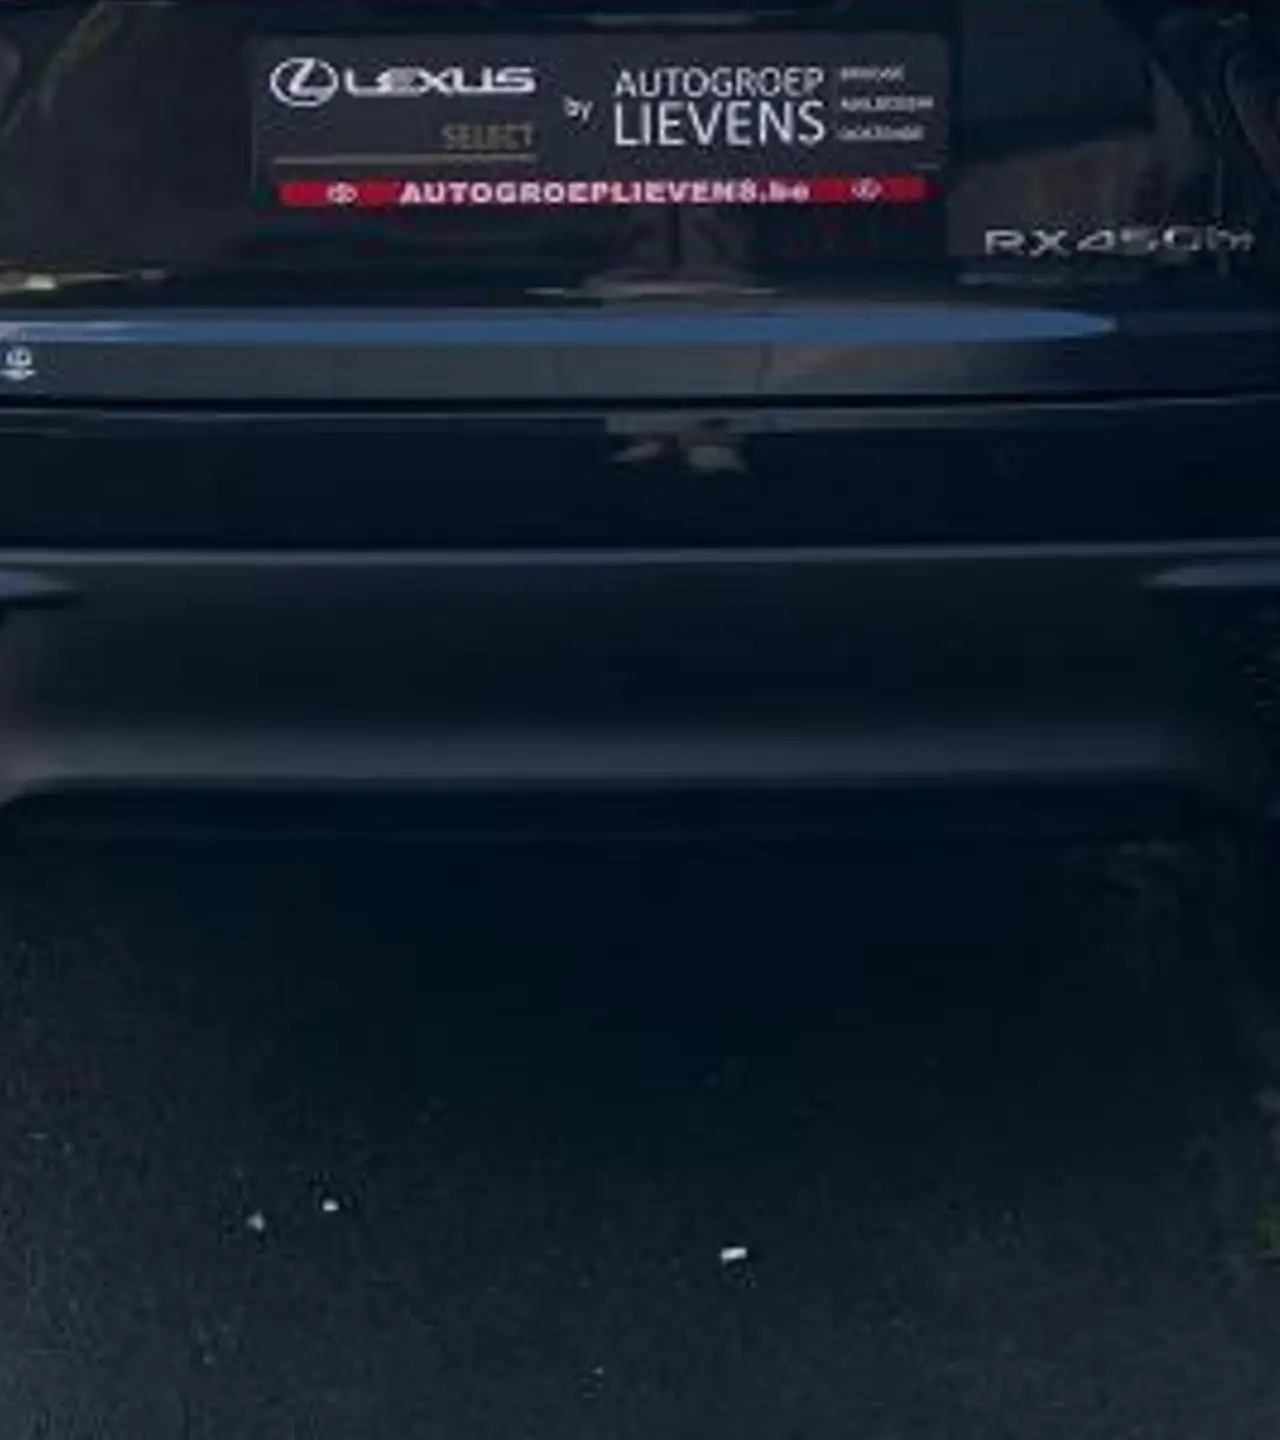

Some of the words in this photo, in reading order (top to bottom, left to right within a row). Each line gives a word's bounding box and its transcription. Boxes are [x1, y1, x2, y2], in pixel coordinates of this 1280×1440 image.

[344, 66, 537, 96] LEXUS
[615, 66, 824, 98] AUTOGROEP
[564, 96, 592, 121] by
[614, 100, 826, 146] LIEVENS
